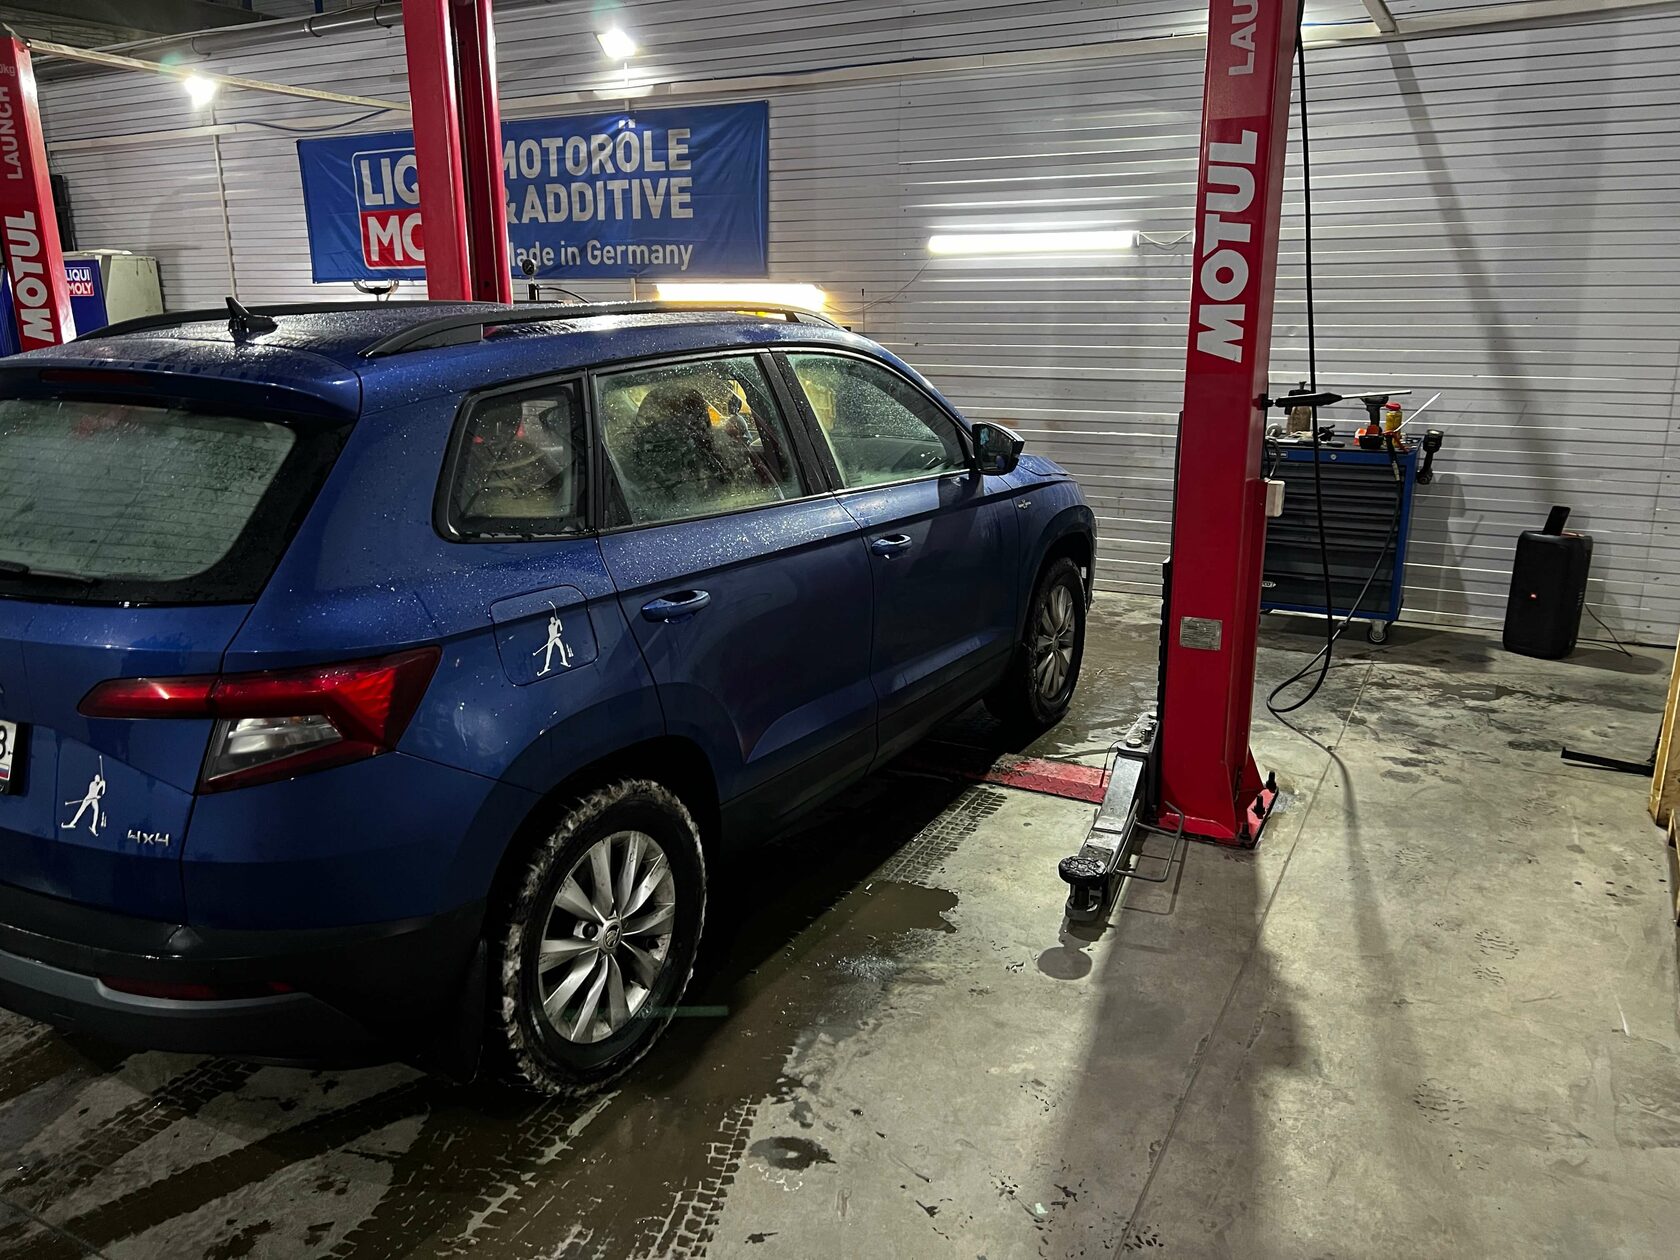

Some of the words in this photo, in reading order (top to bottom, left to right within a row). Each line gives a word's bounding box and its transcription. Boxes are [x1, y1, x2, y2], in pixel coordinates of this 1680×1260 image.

[561, 241, 581, 265] in
[587, 239, 694, 271] Germany
[1196, 130, 1258, 363] MOTUL
[5, 211, 55, 342] MOTUL
[65, 269, 90, 281] LIQUI
[127, 829, 169, 846] 4x4
